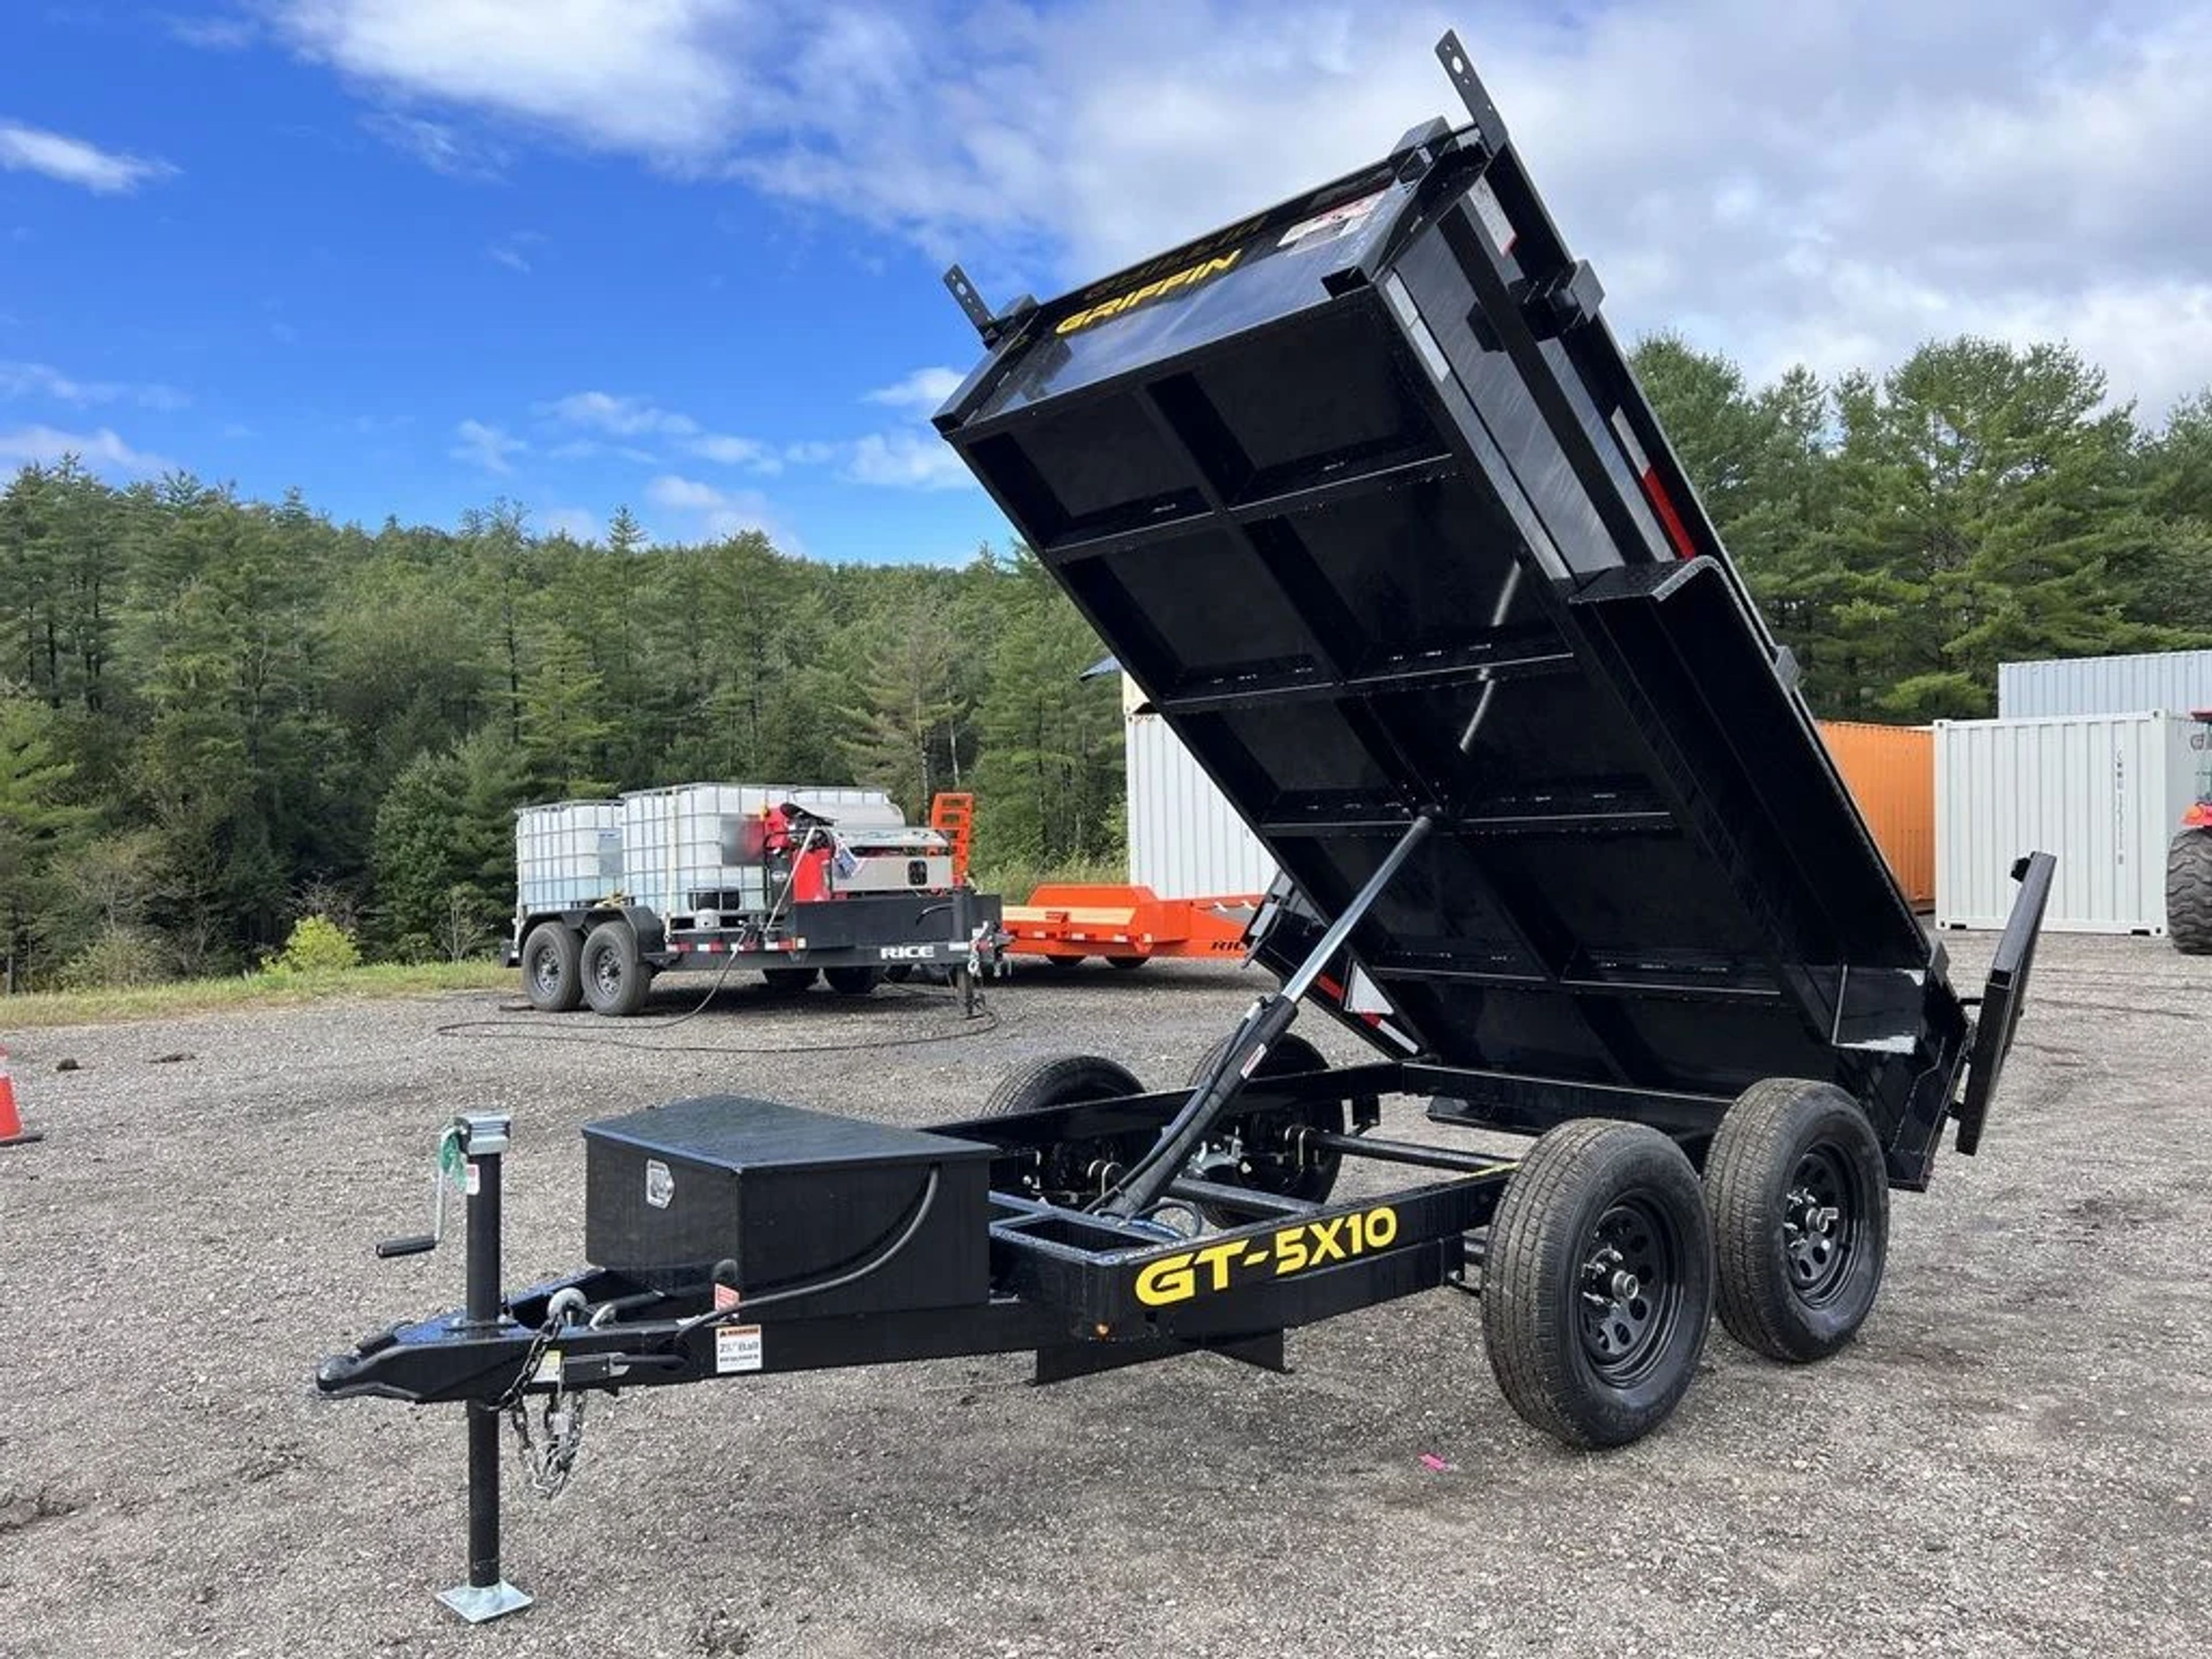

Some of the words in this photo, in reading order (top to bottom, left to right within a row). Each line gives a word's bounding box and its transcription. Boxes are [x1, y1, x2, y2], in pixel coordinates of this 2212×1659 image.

[1056, 248, 1242, 334] GRIFFIN
[880, 945, 934, 960] RICE
[1211, 941, 1244, 951] RIC
[1135, 1206, 1397, 1306] GT-5X10
